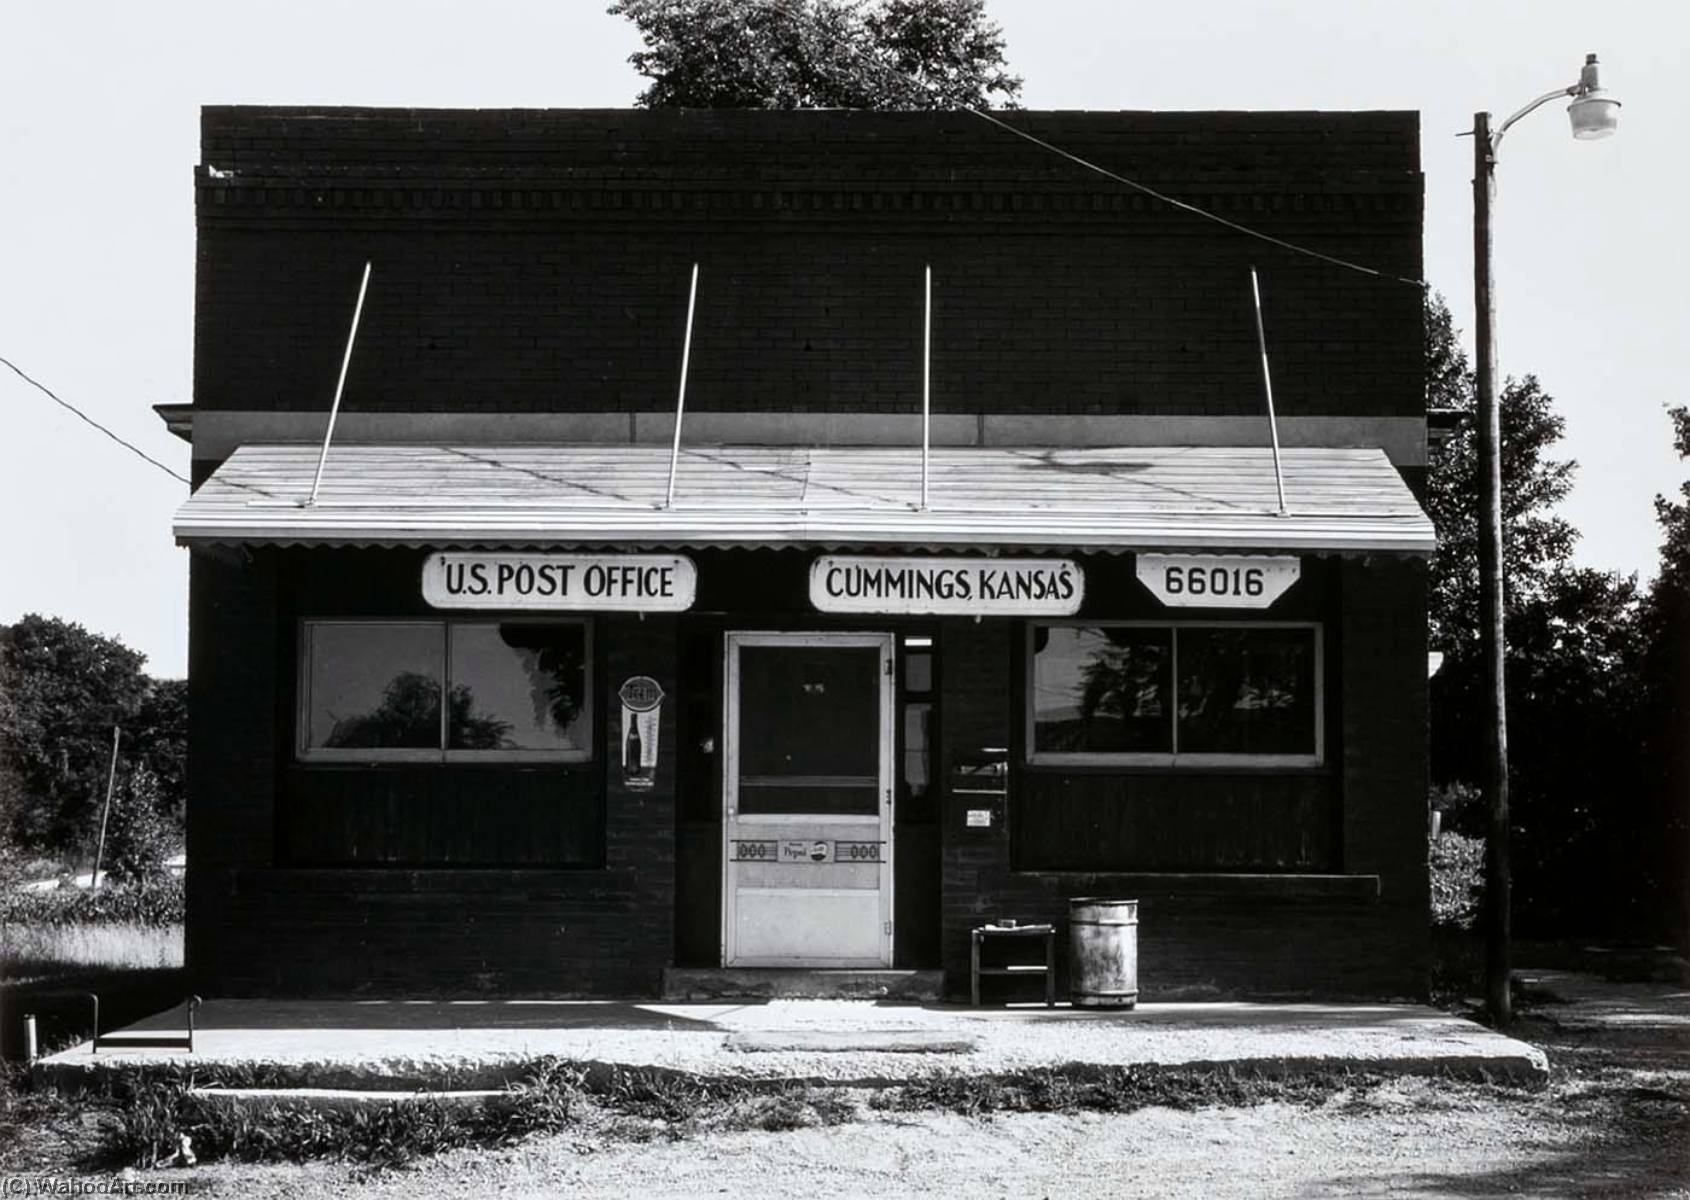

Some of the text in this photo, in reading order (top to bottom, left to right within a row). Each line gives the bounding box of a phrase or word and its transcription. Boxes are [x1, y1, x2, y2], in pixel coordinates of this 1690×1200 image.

[446, 563, 674, 597] U.S. POST OFFICE
[825, 567, 1074, 601] CUMMINGS, KANSAS
[1165, 566, 1264, 597] 66016
